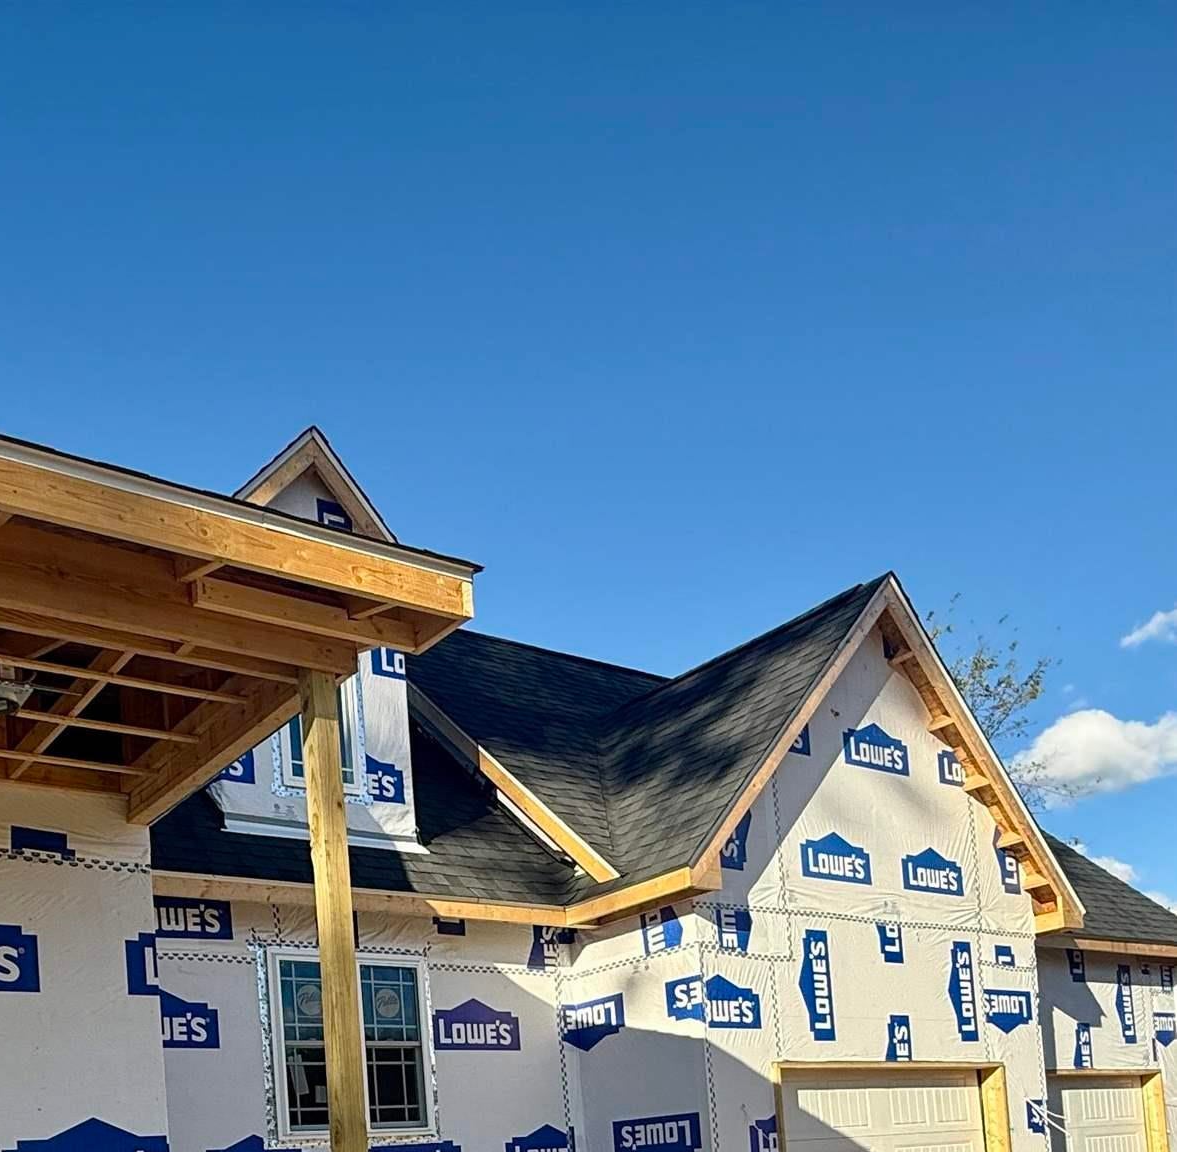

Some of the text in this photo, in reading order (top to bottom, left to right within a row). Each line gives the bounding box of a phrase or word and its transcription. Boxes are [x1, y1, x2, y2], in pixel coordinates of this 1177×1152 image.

[850, 737, 903, 770] LOWE'S
[808, 848, 866, 879] LOWE'S
[909, 863, 958, 891] LOWE'S
[155, 904, 220, 932] WE'S
[809, 940, 831, 1030] LOWE'S
[957, 951, 975, 1031] LOWE'S
[438, 1019, 512, 1045] LOWE'S
[621, 1120, 691, 1150] LOWE'S
